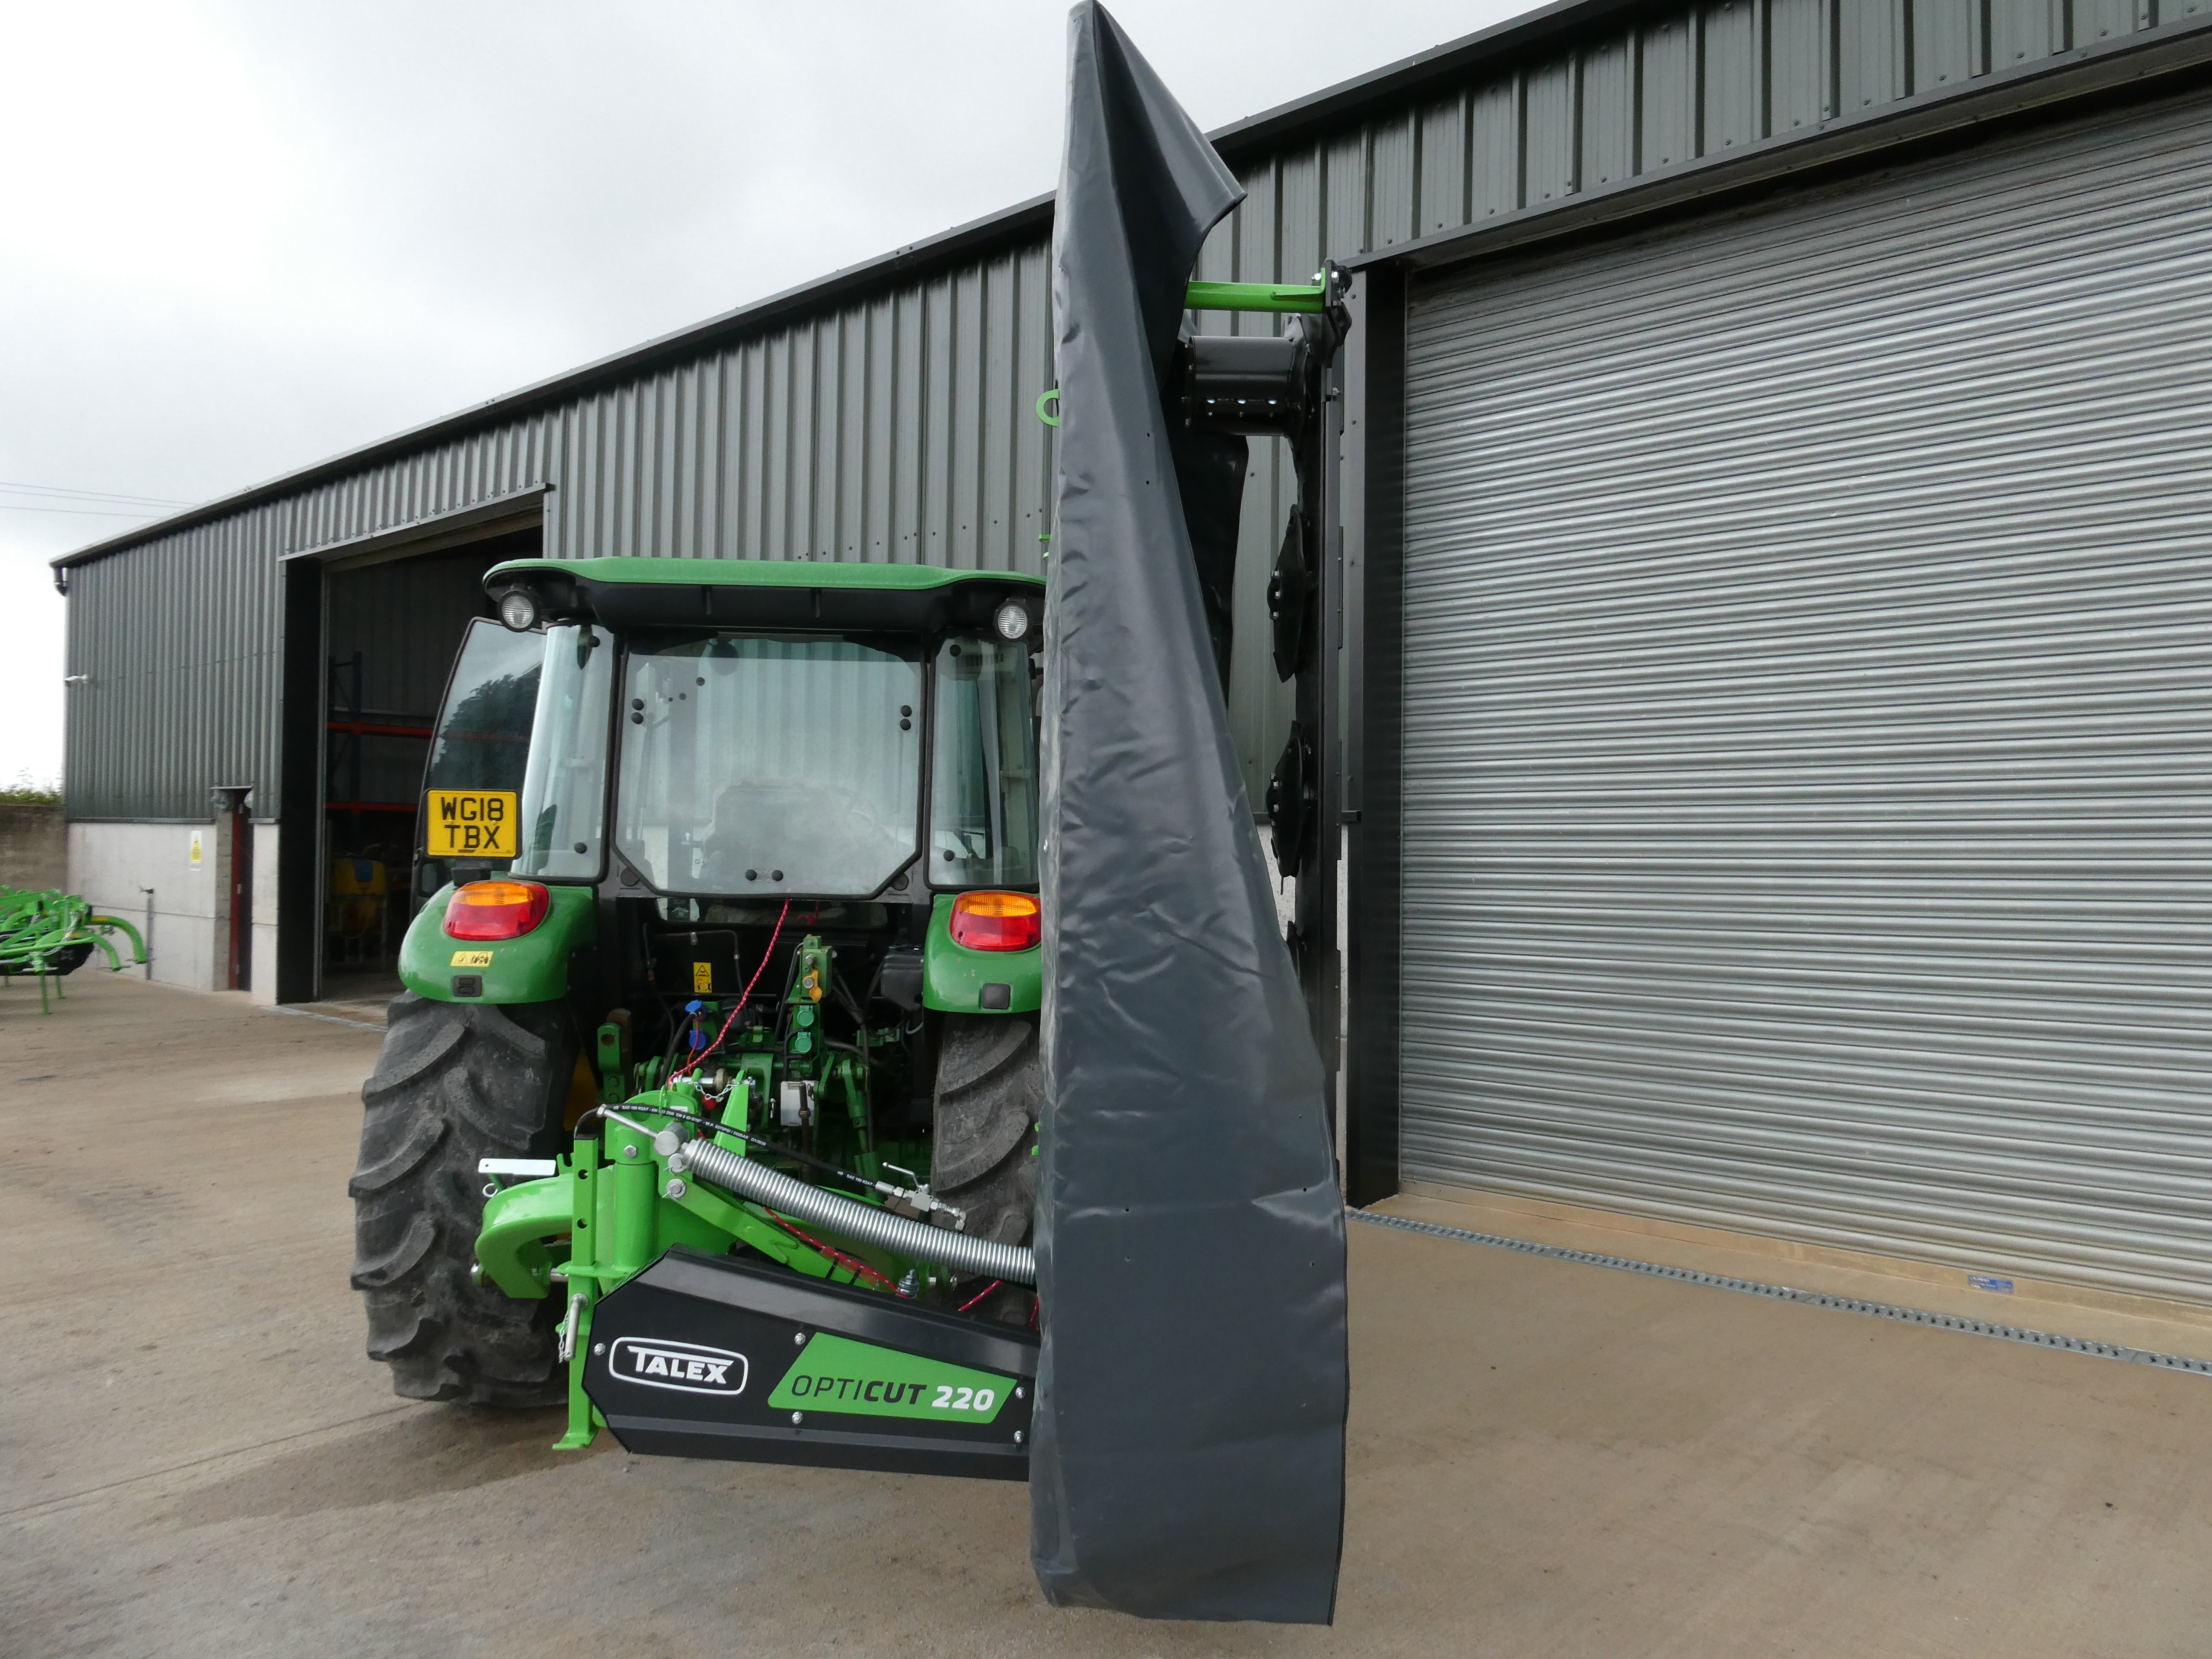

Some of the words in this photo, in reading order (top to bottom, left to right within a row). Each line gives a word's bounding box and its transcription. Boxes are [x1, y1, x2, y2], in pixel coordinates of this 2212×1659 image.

[440, 796, 504, 821] WG18
[444, 824, 500, 849] TBX
[627, 1345, 734, 1384] TALEX
[791, 1375, 927, 1405] OPTICUT
[932, 1385, 995, 1411] 220
